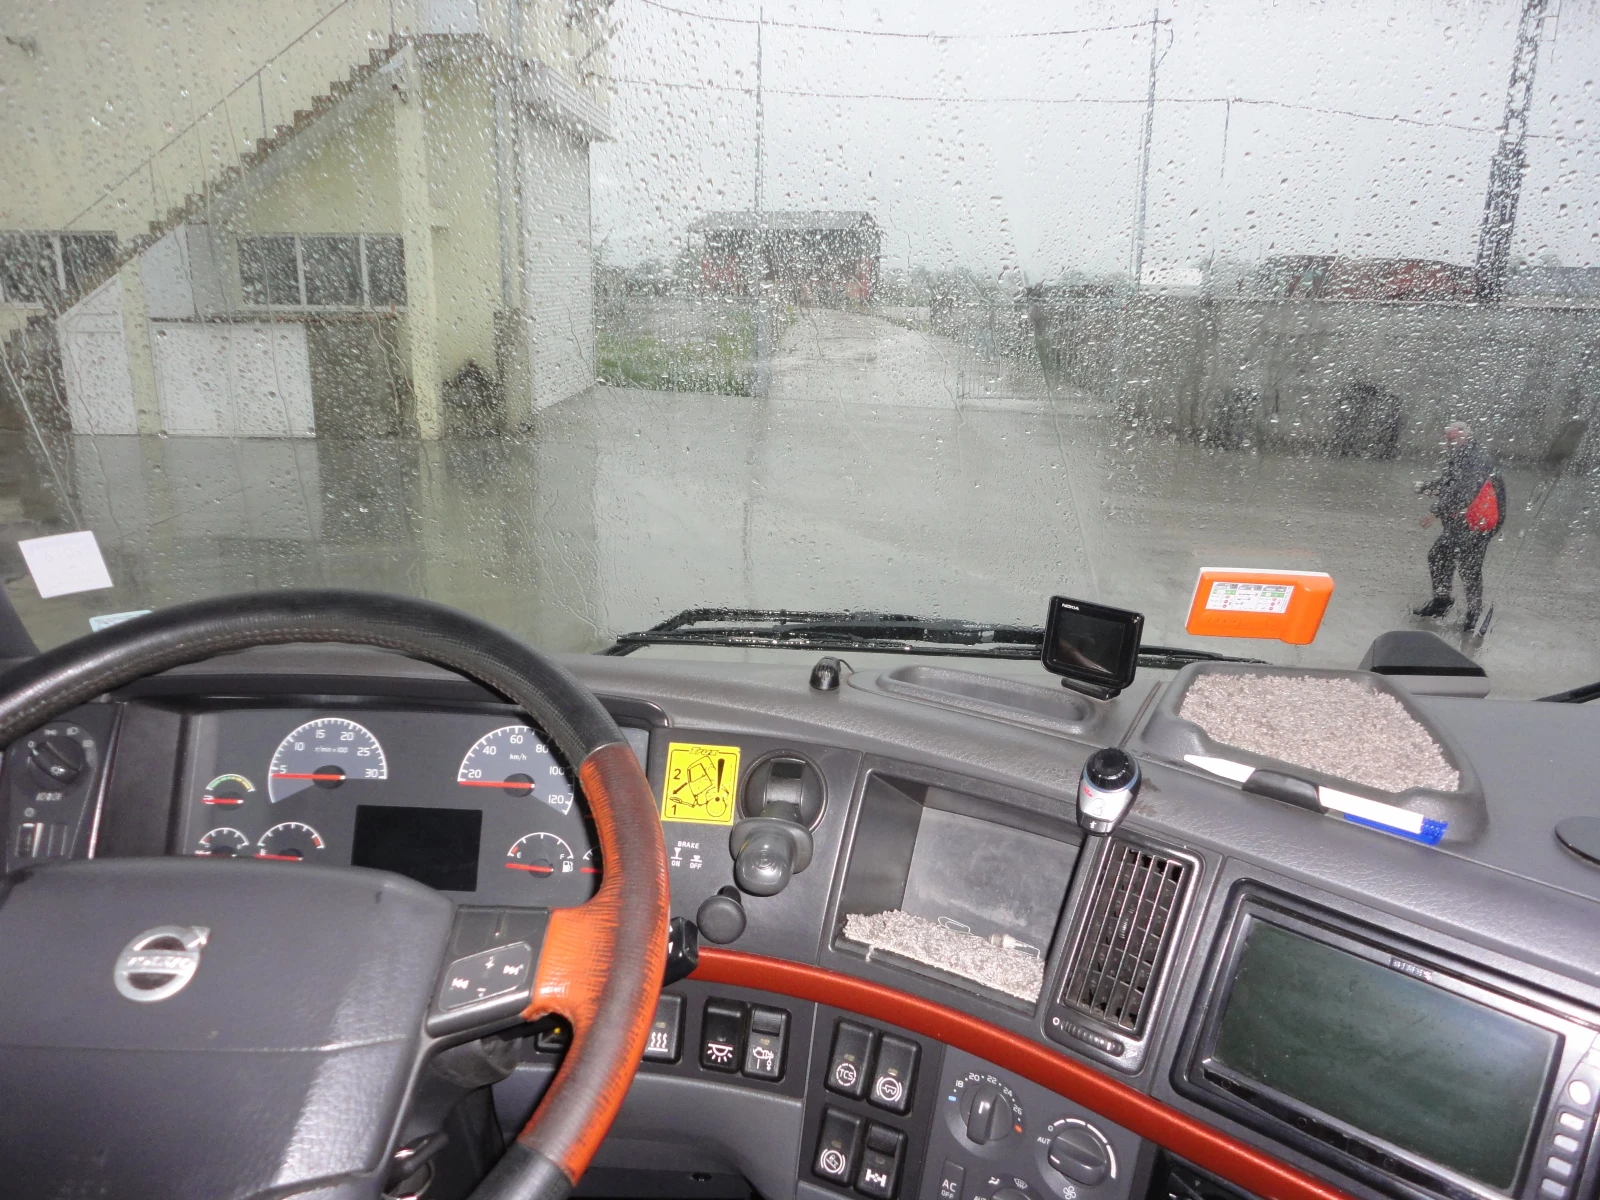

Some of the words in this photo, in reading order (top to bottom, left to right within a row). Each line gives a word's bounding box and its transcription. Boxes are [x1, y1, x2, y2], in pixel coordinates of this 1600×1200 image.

[315, 729, 326, 739] 15
[340, 731, 355, 741] 20
[509, 734, 524, 744] 60
[294, 741, 305, 751] 10
[482, 745, 497, 755] 40
[356, 746, 371, 757] 25
[509, 753, 527, 761] km/h
[279, 765, 287, 774] 5
[364, 768, 379, 778] 30
[468, 768, 482, 779] 20
[549, 765, 565, 776] 100
[673, 768, 682, 780] 2
[548, 794, 565, 804] 120
[671, 803, 677, 816] 1
[677, 840, 700, 850] BRAKE
[689, 861, 703, 870] OFF
[839, 1068, 854, 1081] TCS
[968, 1072, 980, 1082] 20
[986, 1074, 998, 1085] 22
[955, 1079, 964, 1088] 18
[1003, 1086, 1013, 1097] 24
[1012, 1103, 1023, 1116] 26
[1036, 1136, 1051, 1145] AUT
[941, 1178, 957, 1193] AC
[941, 1189, 954, 1200] OFF
